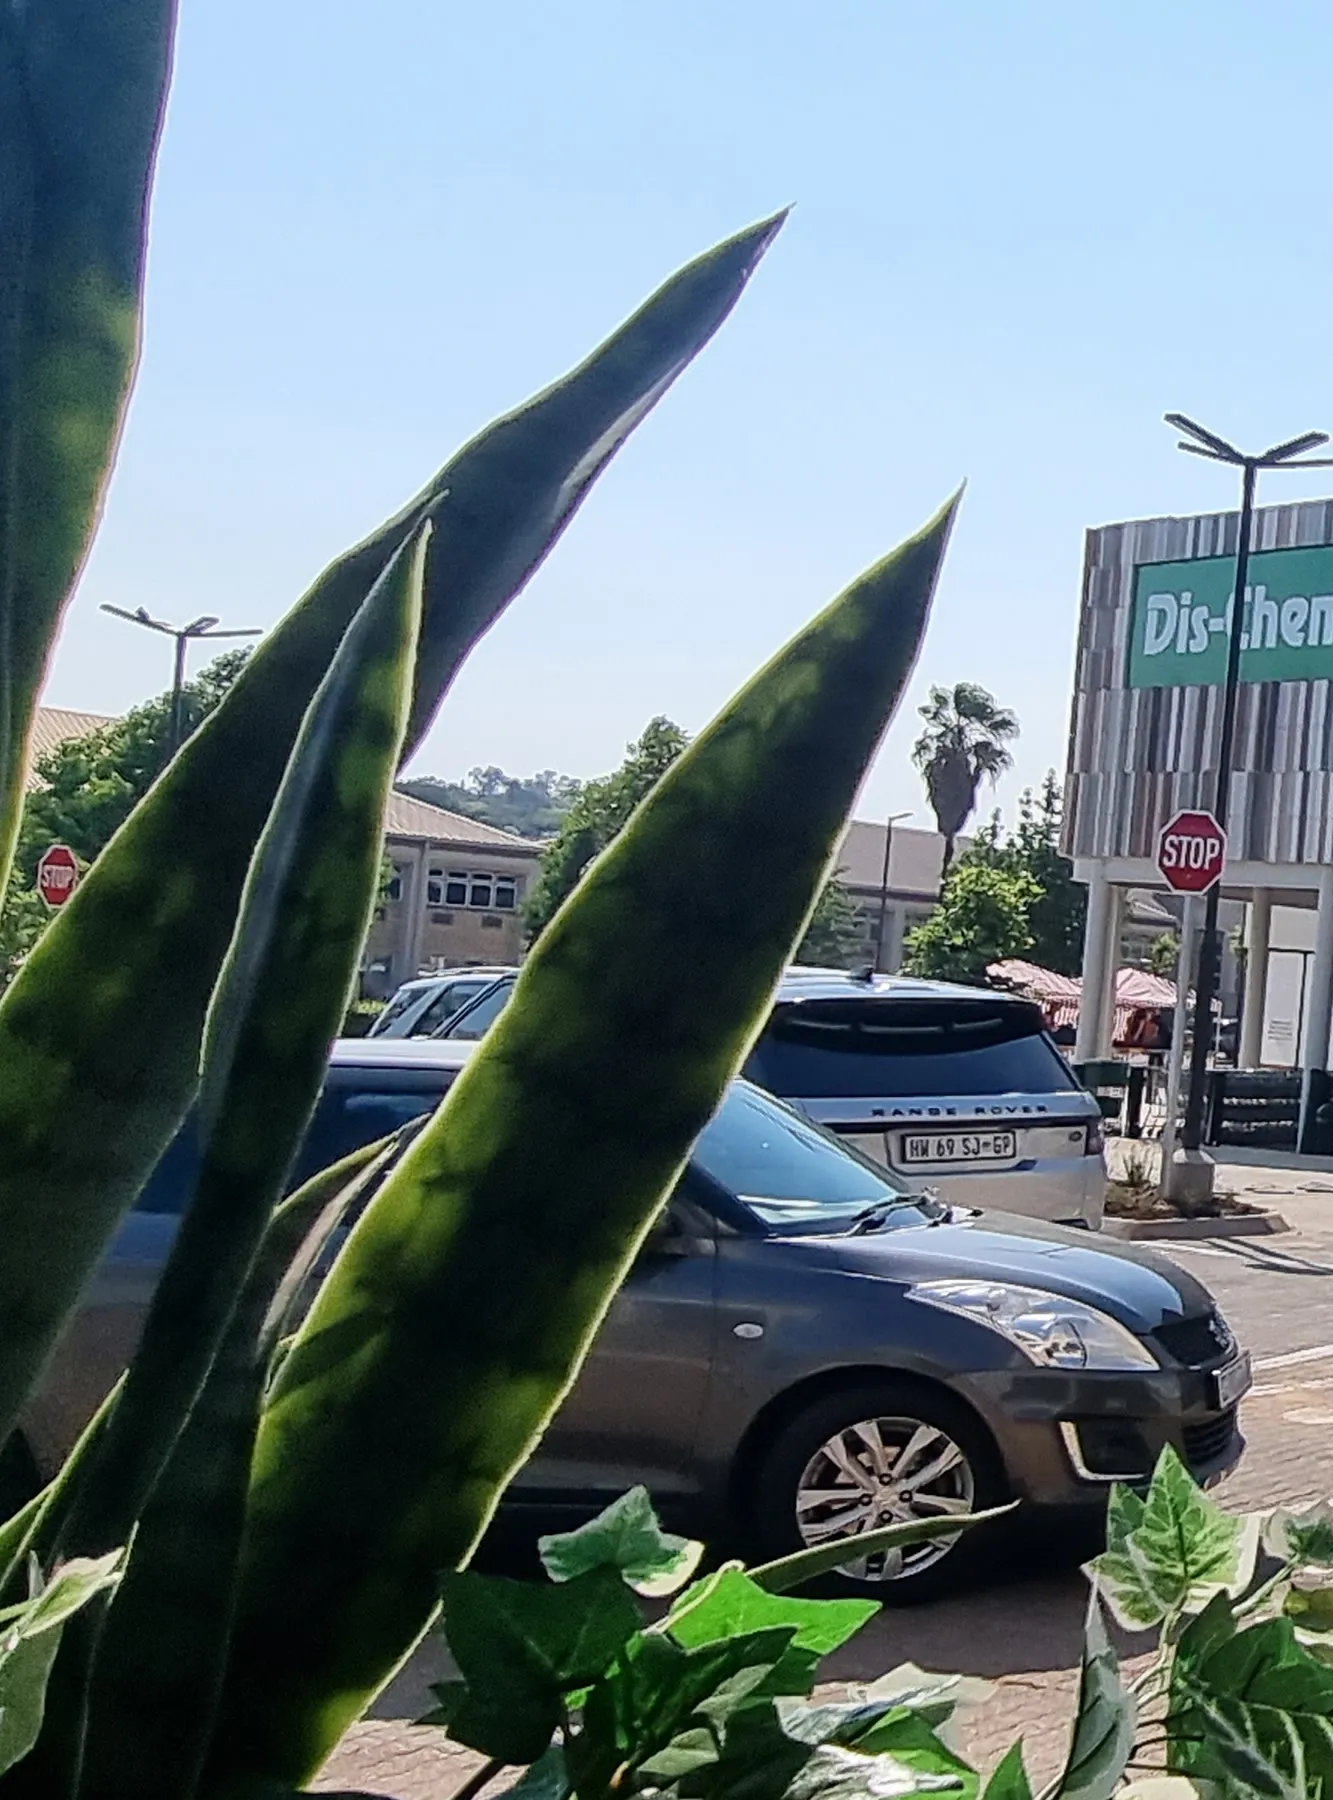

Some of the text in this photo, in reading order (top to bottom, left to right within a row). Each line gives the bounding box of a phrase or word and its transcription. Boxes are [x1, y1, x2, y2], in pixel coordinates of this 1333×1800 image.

[1163, 834, 1221, 871] STOP
[41, 864, 74, 889] STOP
[871, 1104, 1048, 1117] RANGE ROVER
